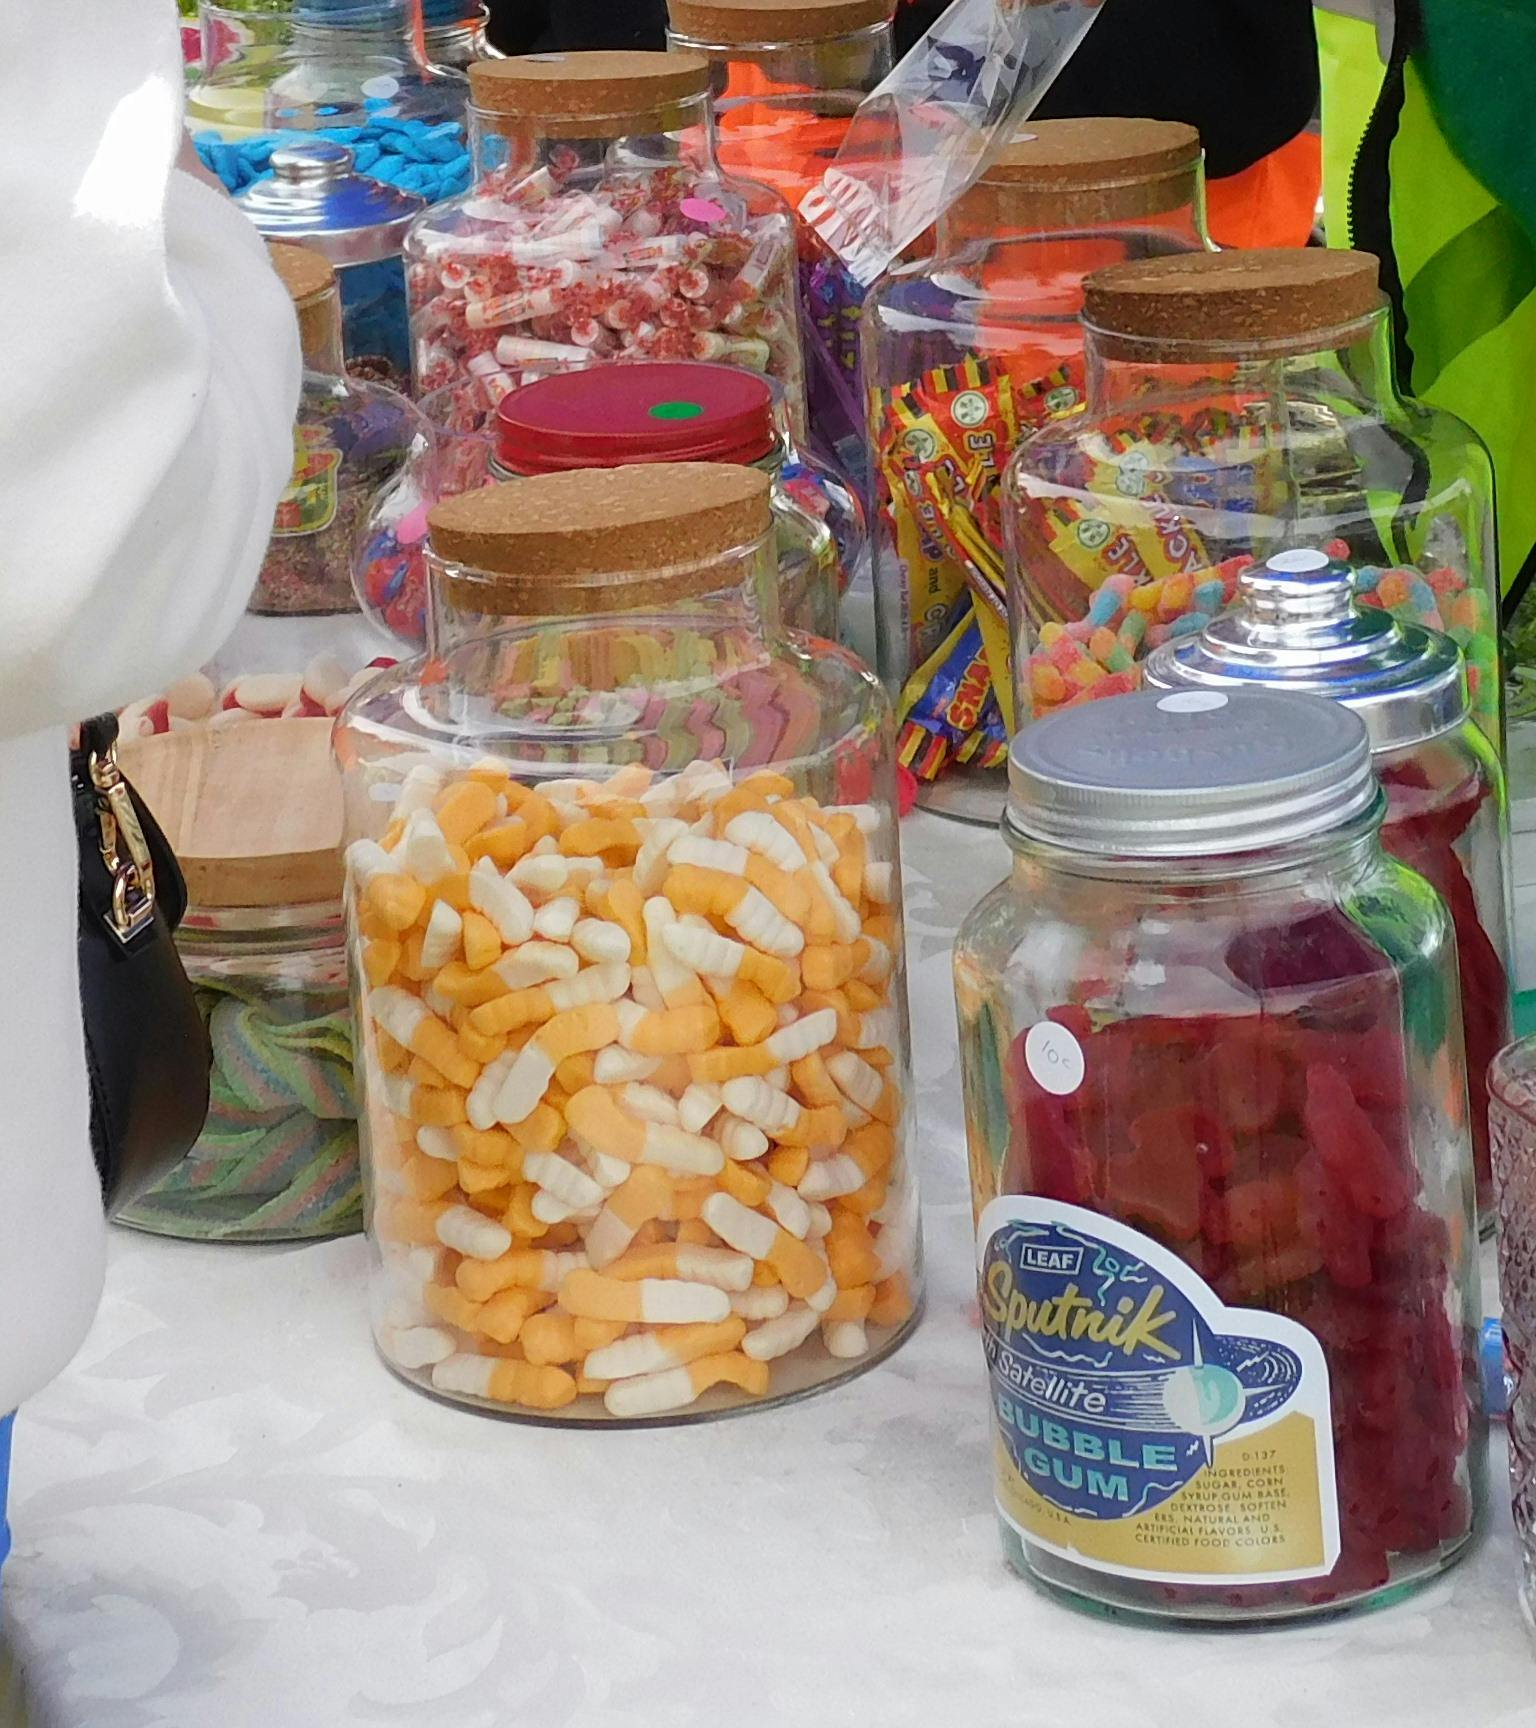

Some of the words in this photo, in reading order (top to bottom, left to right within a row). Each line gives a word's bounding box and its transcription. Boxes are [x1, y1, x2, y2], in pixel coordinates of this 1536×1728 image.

[946, 646, 991, 731] SNA
[1026, 1248, 1074, 1270] LEAF
[983, 1260, 1181, 1361] Sputnik
[999, 1350, 1106, 1413] Satellite
[997, 1391, 1178, 1472] BUBBLE
[1023, 1447, 1129, 1502] GUM
[1247, 1478, 1283, 1488] CORN
[1136, 1522, 1194, 1535] ARTIFICIAL
[1184, 1514, 1237, 1524] NATURAL
[1243, 1513, 1271, 1522] AND
[1135, 1534, 1190, 1547] CERTIFIED
[1194, 1538, 1231, 1548] FOOD
